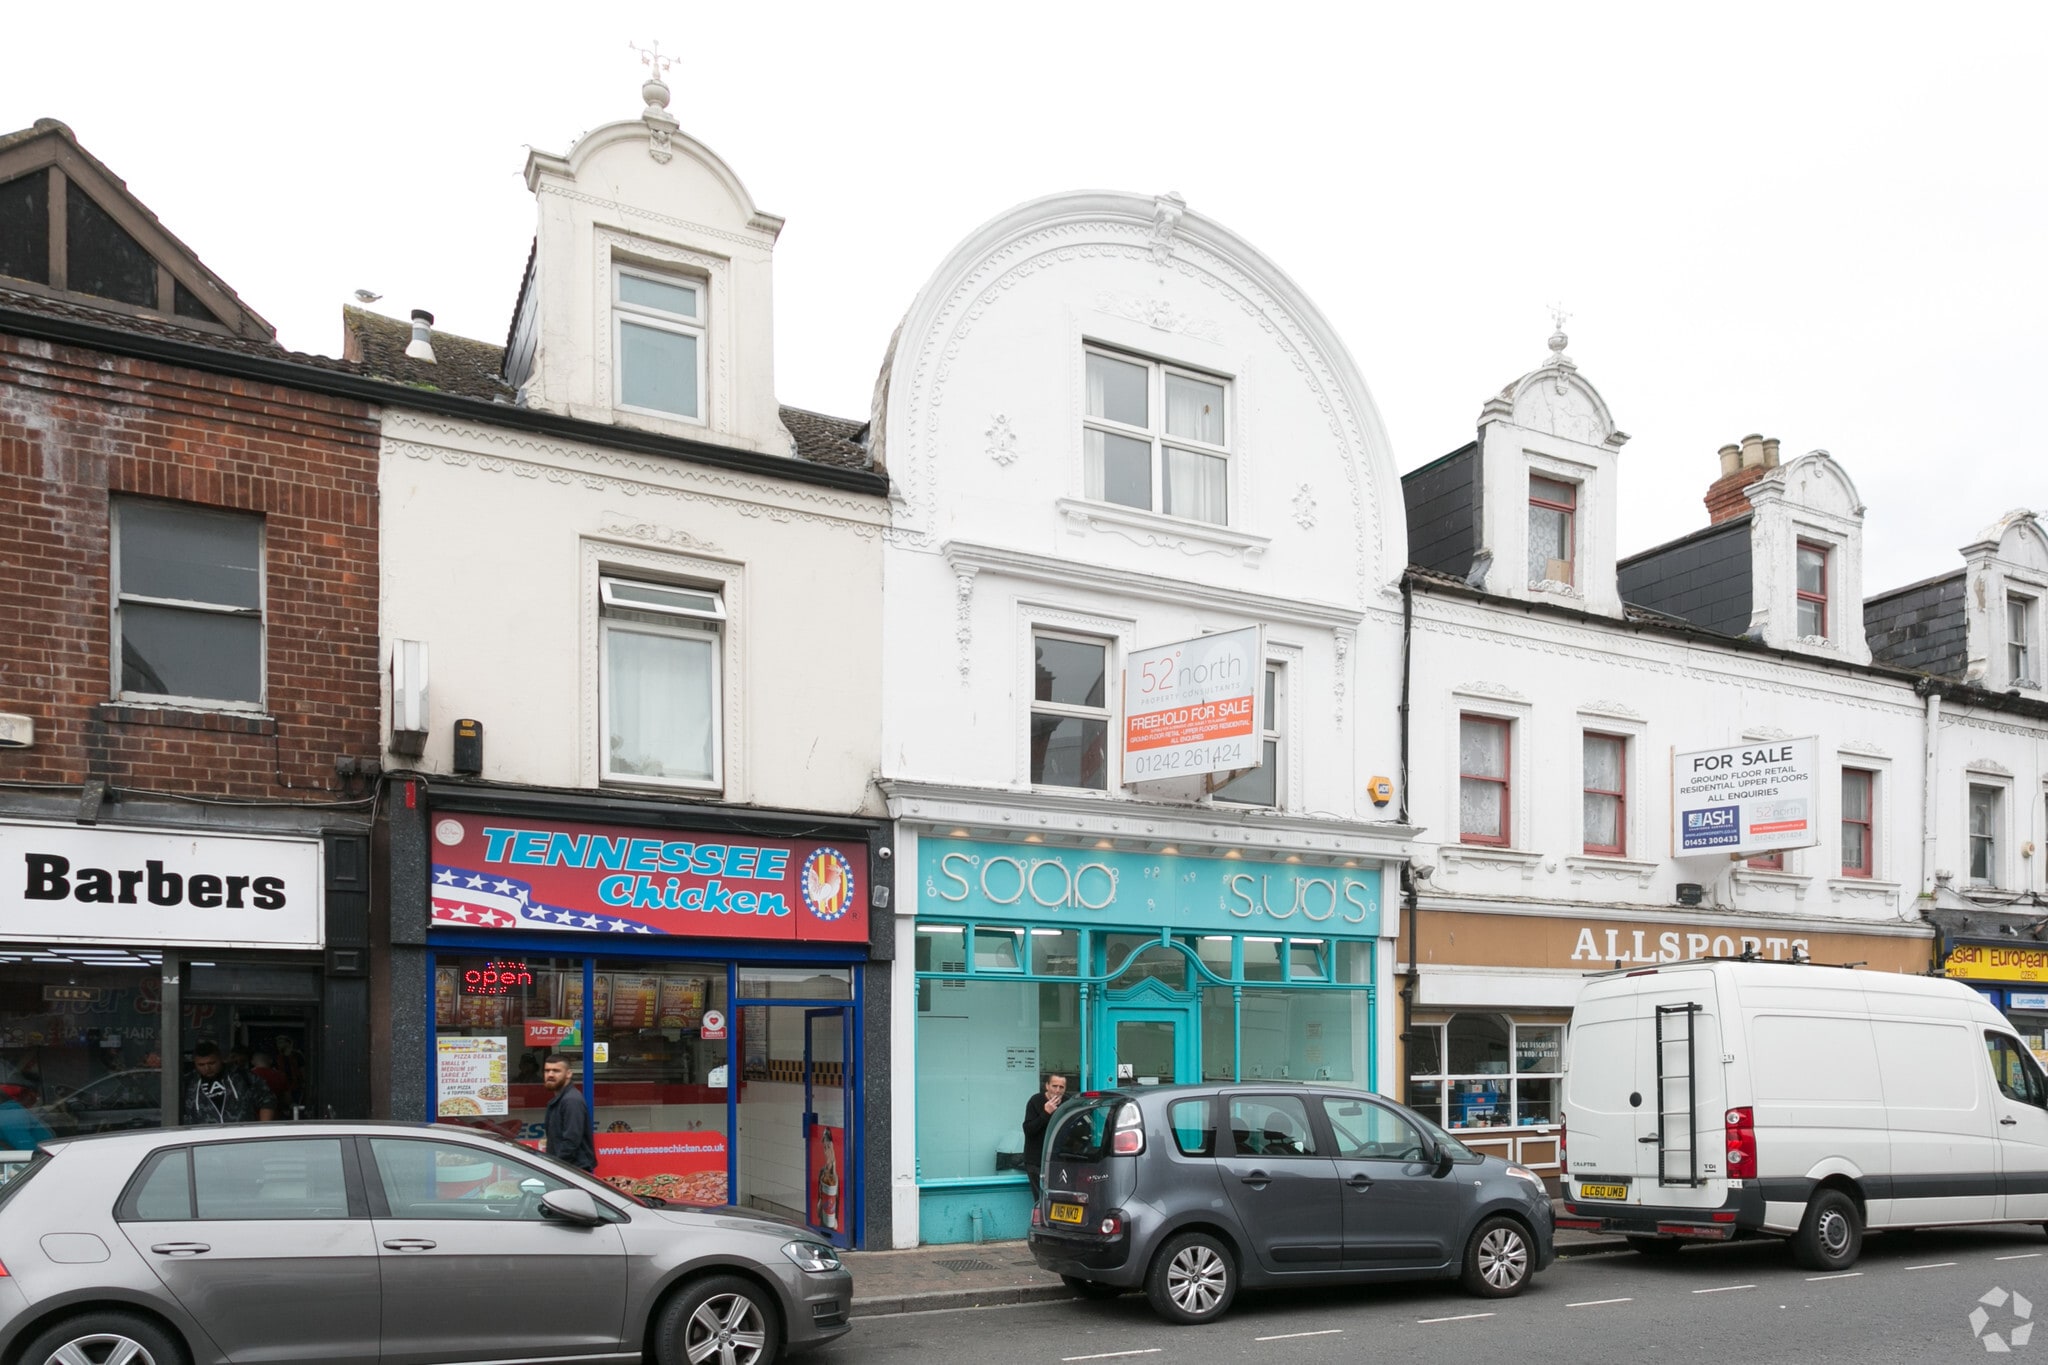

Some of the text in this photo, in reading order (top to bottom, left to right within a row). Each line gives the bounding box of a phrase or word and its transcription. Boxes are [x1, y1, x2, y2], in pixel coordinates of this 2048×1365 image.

[1179, 653, 1240, 686] north
[1141, 682, 1241, 705] PROPERTY CONSULTANTS
[1131, 710, 1188, 731] FREEHOLD
[1191, 705, 1215, 721] FOR
[1219, 699, 1250, 717] SALE
[1130, 734, 1149, 743] GROUND
[1199, 724, 1219, 732] FLOORS
[1220, 719, 1250, 729] RESIDENTIAL
[1180, 734, 1204, 743] ENQUIRIES
[1136, 743, 1241, 773] 01242 261424
[1694, 746, 1793, 772] FOR SALE
[1680, 773, 1809, 794] RESIDENTIAL UPPER FLOORS
[1690, 766, 1796, 785] GROUND FLOOR RETAIL
[1707, 788, 1779, 802] ALL ENQUIRIES
[1702, 809, 1733, 827] ASH
[1773, 807, 1801, 817] north
[1685, 835, 1738, 847] 01452 300433
[482, 827, 790, 880] TENNESSEE
[24, 852, 287, 911] Barbers
[598, 874, 791, 917] Chicken
[1571, 928, 1811, 963] ALLSPORTS
[465, 970, 532, 987] open
[530, 1026, 576, 1036] JUST EAT
[599, 1143, 725, 1155] www.tennesseechicken.co.uk
[1584, 1186, 1623, 1198] LC60 UMB
